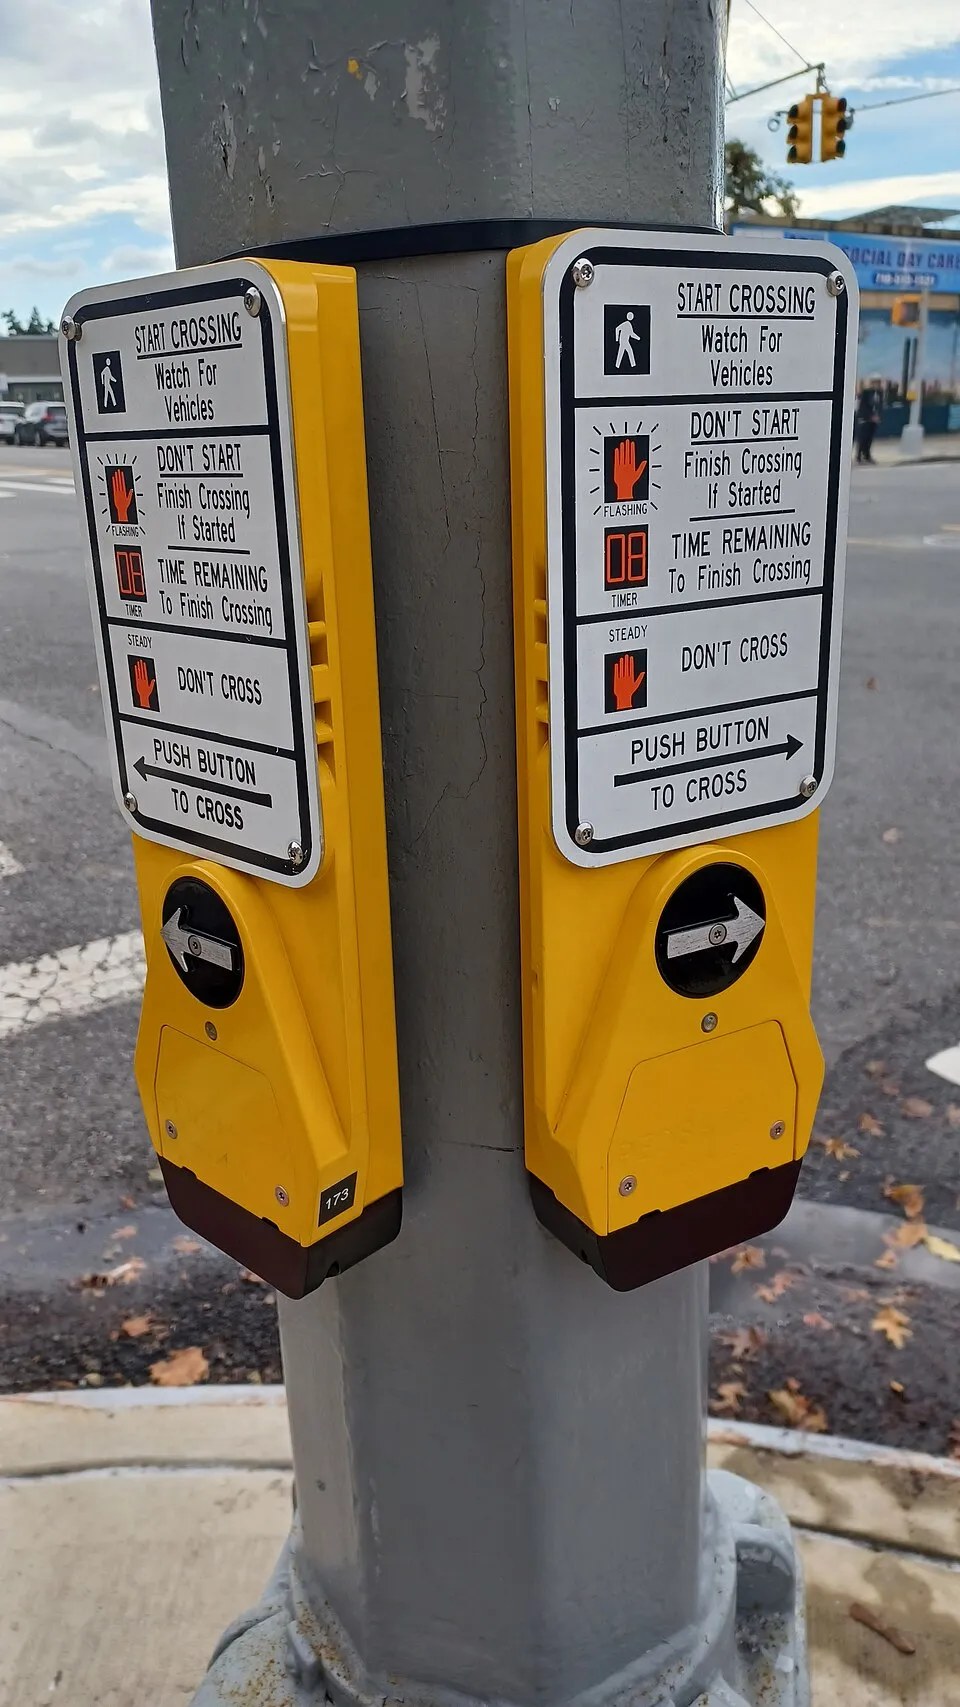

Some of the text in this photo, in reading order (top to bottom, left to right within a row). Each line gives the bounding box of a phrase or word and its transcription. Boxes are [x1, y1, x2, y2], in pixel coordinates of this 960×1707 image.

[897, 251, 922, 267] DAY
[677, 282, 816, 314] START CROSSING
[134, 311, 242, 354] START CROSSING
[701, 324, 783, 353] Watch For
[154, 358, 217, 391] Watch For
[710, 359, 773, 387] Vehicles
[164, 394, 215, 423] Vehicles
[690, 408, 800, 439] DON'T START
[156, 443, 241, 472] DON'T START
[684, 446, 802, 479] Finish Crossing
[157, 482, 250, 519] Finish Crossing
[708, 479, 781, 509] If Started
[603, 503, 648, 518] FLASHING
[111, 525, 139, 538] FLASHING
[178, 514, 236, 543] If Started
[671, 521, 811, 560] TIME REMAINING
[116, 551, 145, 596] 08
[606, 531, 646, 584] 08
[157, 558, 268, 593] TIME REMAINING
[668, 554, 811, 594] To Finish Crossing
[125, 603, 143, 617] TIMER
[159, 589, 273, 636] To Finish Crossing
[611, 592, 638, 608] TIMER
[127, 633, 152, 648] STEADY
[608, 625, 648, 643] STEADY
[681, 632, 788, 673] DON'T CROSS
[177, 666, 262, 706] DON'T CROSS
[631, 716, 770, 765] PUSH BUTTON
[153, 738, 256, 786] PUSH BUTTON
[651, 768, 747, 811] TO CROSS
[171, 788, 244, 830] TO CROSS
[326, 1188, 349, 1210] 173
